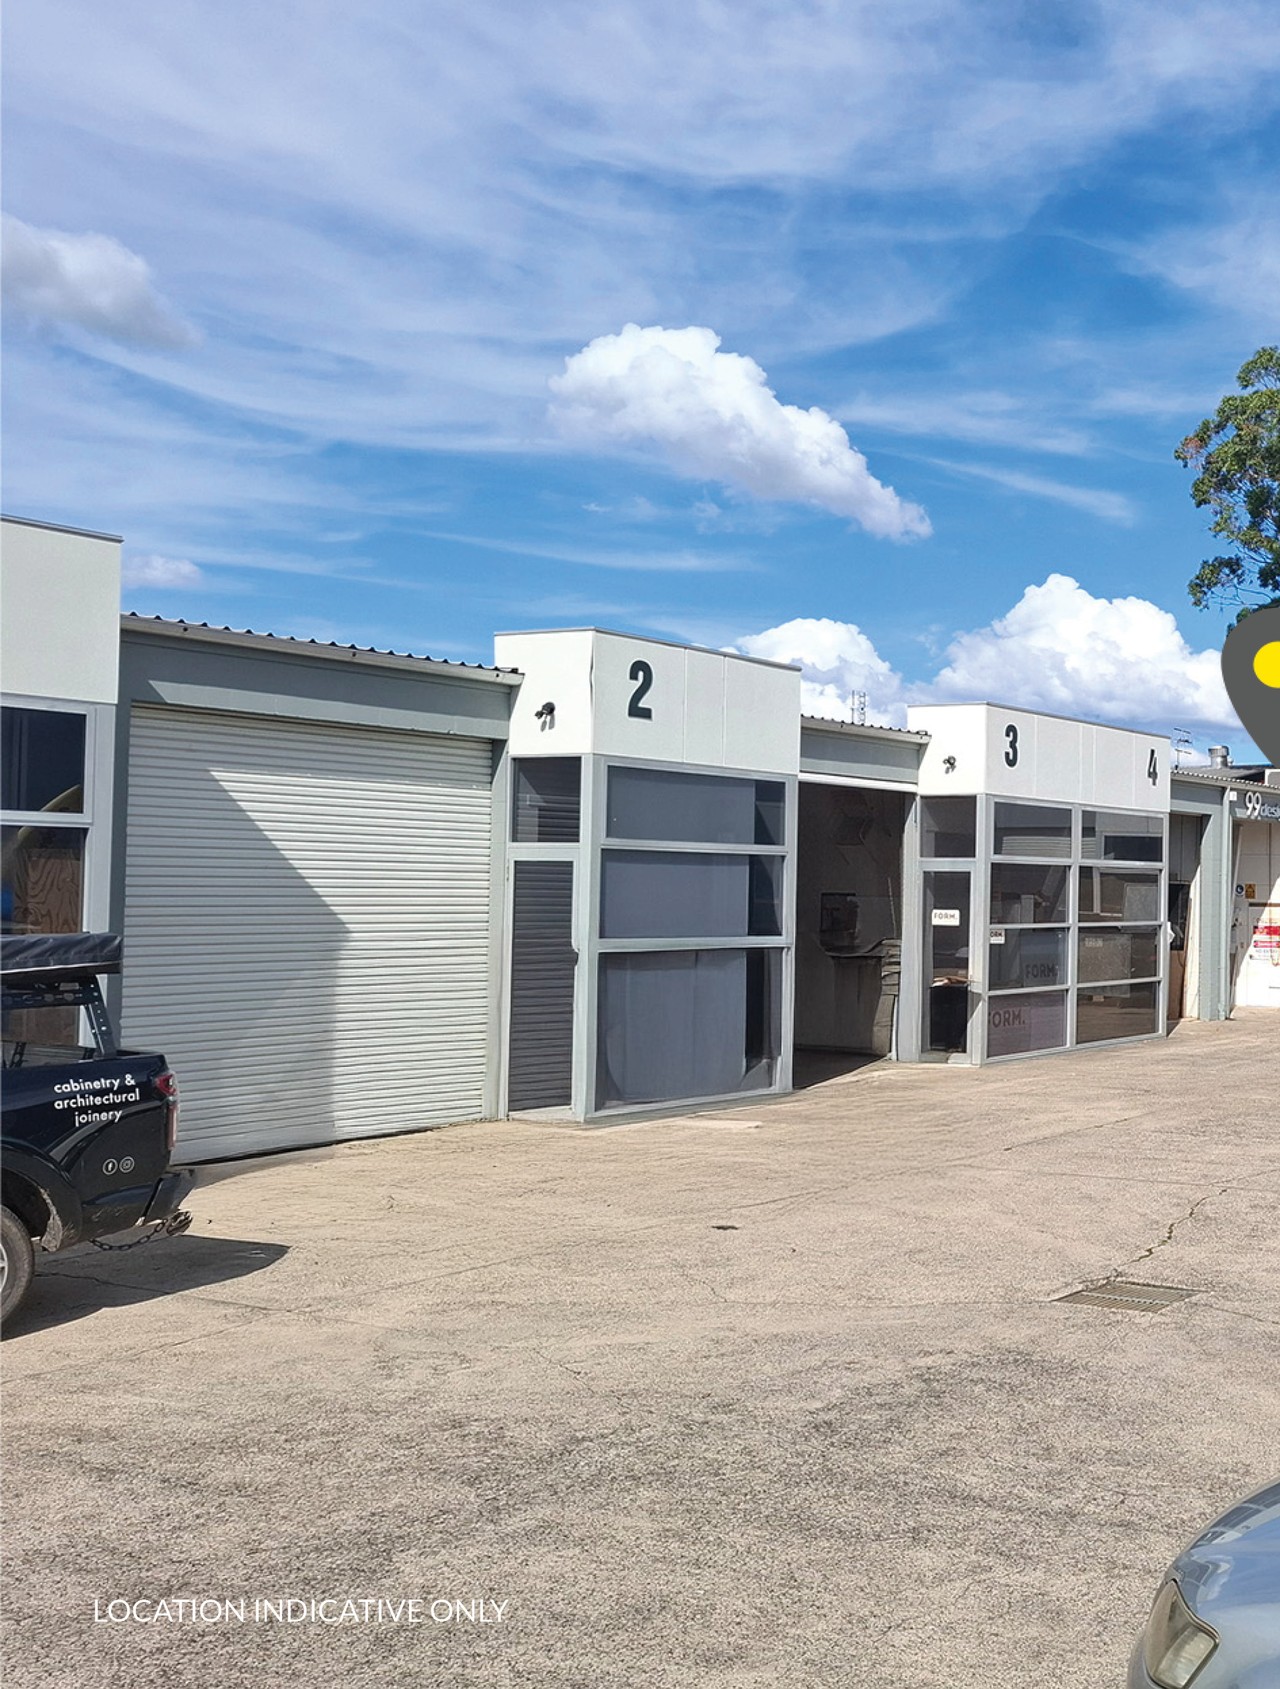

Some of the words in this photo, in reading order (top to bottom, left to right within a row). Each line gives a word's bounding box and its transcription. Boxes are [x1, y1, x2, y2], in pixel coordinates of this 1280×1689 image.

[628, 659, 653, 720] 2
[1005, 724, 1018, 768] 3
[1147, 748, 1158, 786] 4
[989, 1009, 1026, 1028] ORM.
[54, 1078, 120, 1093] cabinetry
[125, 1073, 135, 1086] &
[54, 1088, 141, 1109] architectural
[75, 1110, 122, 1127] joinery
